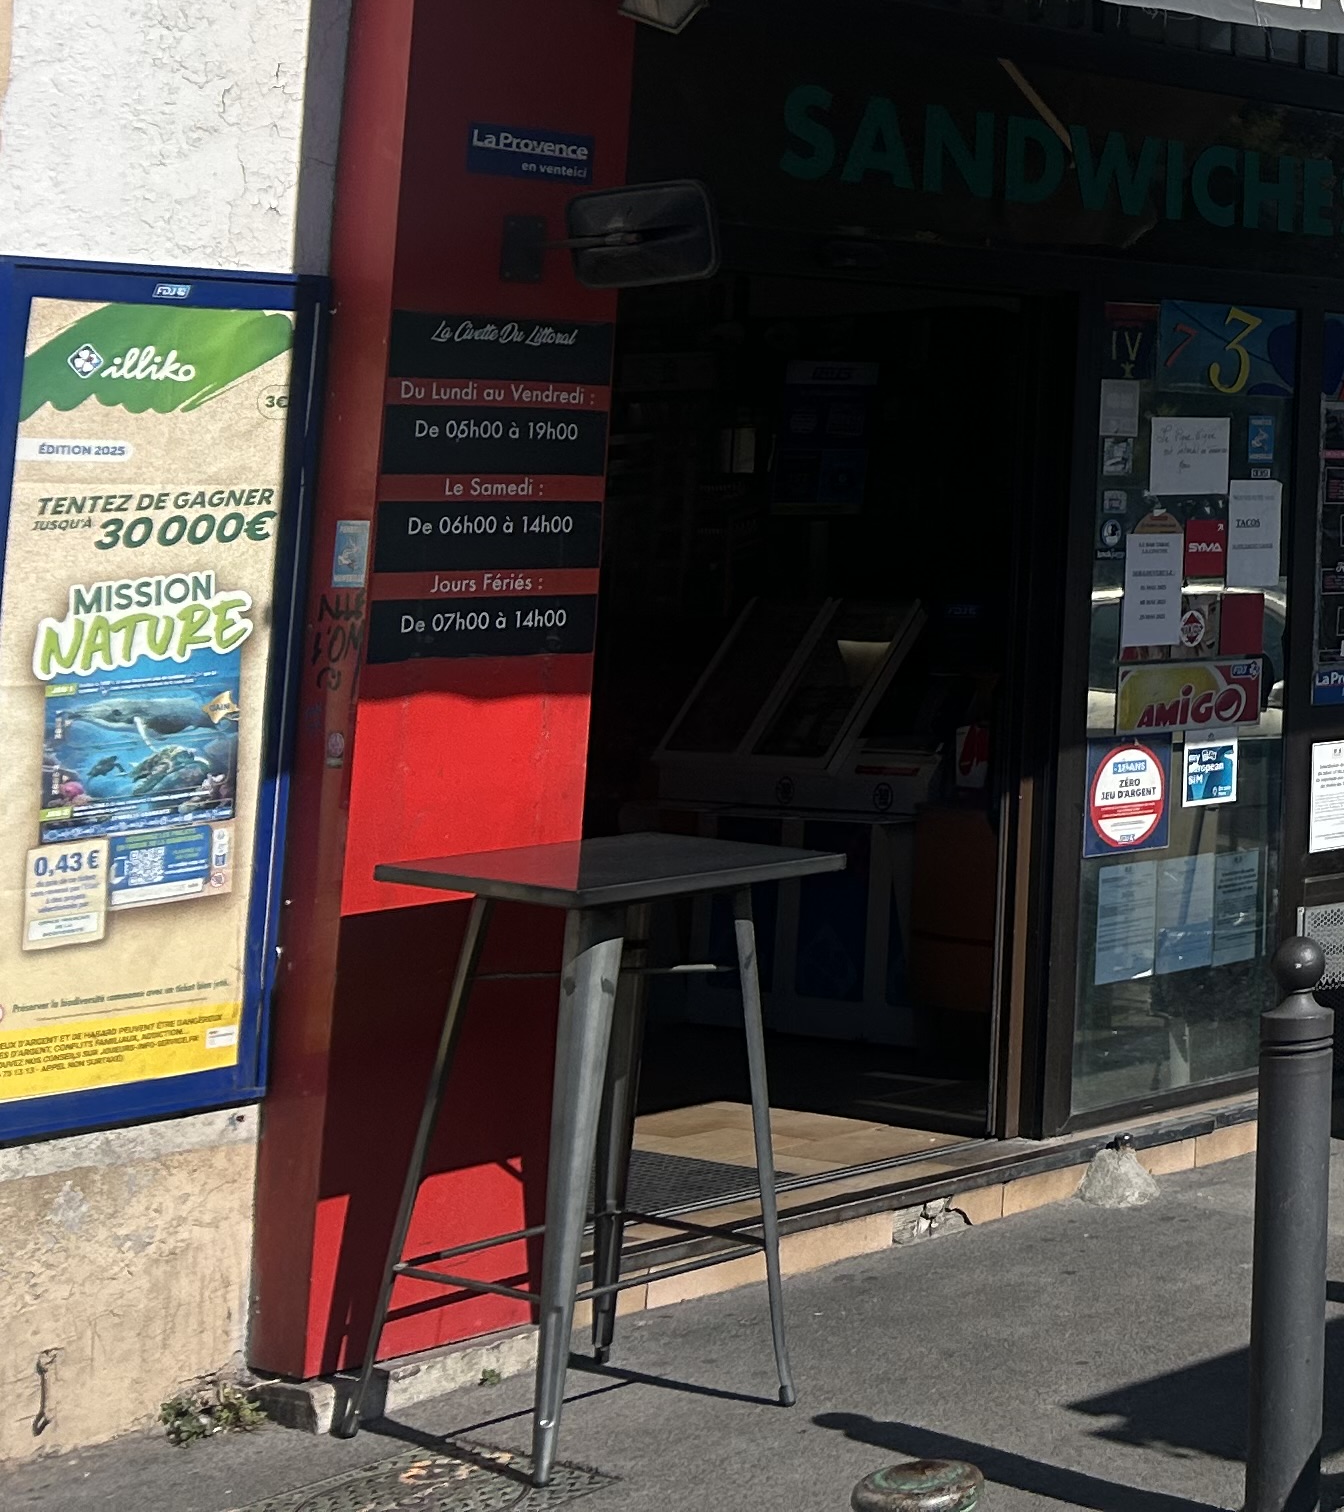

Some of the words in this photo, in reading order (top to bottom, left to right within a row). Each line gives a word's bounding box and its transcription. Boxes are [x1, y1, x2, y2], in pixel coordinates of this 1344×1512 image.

[499, 131, 589, 160] Provence
[431, 320, 453, 343] La
[499, 322, 526, 344] Du
[1164, 322, 1199, 368] 7
[1208, 305, 1263, 394] 3
[100, 345, 196, 382] illiko
[401, 381, 425, 399] Du
[432, 381, 478, 401] Lundi
[483, 388, 505, 401] au
[511, 384, 584, 405] Vendredi
[415, 419, 439, 438] De
[508, 421, 520, 439] à
[528, 421, 579, 441] 19h00
[38, 443, 92, 456] ÉDITION
[94, 445, 125, 456] 2025
[445, 478, 464, 496] Le
[470, 477, 534, 496] Samedi
[37, 494, 133, 516] TENTEZ
[136, 492, 170, 512] DE
[173, 488, 275, 509] GAGNER
[31, 517, 92, 532] JUSQU'À
[407, 516, 433, 535] De
[438, 515, 498, 534] 06h00
[502, 515, 514, 534] à
[521, 515, 574, 534] 14h00
[1235, 518, 1261, 529] TACOS
[73, 574, 212, 616] MISSION
[429, 575, 477, 593] Jours
[482, 573, 533, 591] Fériés
[400, 615, 426, 634] De
[431, 611, 490, 632] 07h00
[495, 611, 507, 630] à
[514, 608, 568, 629] 14h00
[40, 598, 249, 676] NATURE
[1316, 672, 1329, 686] La
[1118, 777, 1141, 789] ZÉRO
[34, 852, 83, 877] 0,43
[87, 849, 100, 869] €
